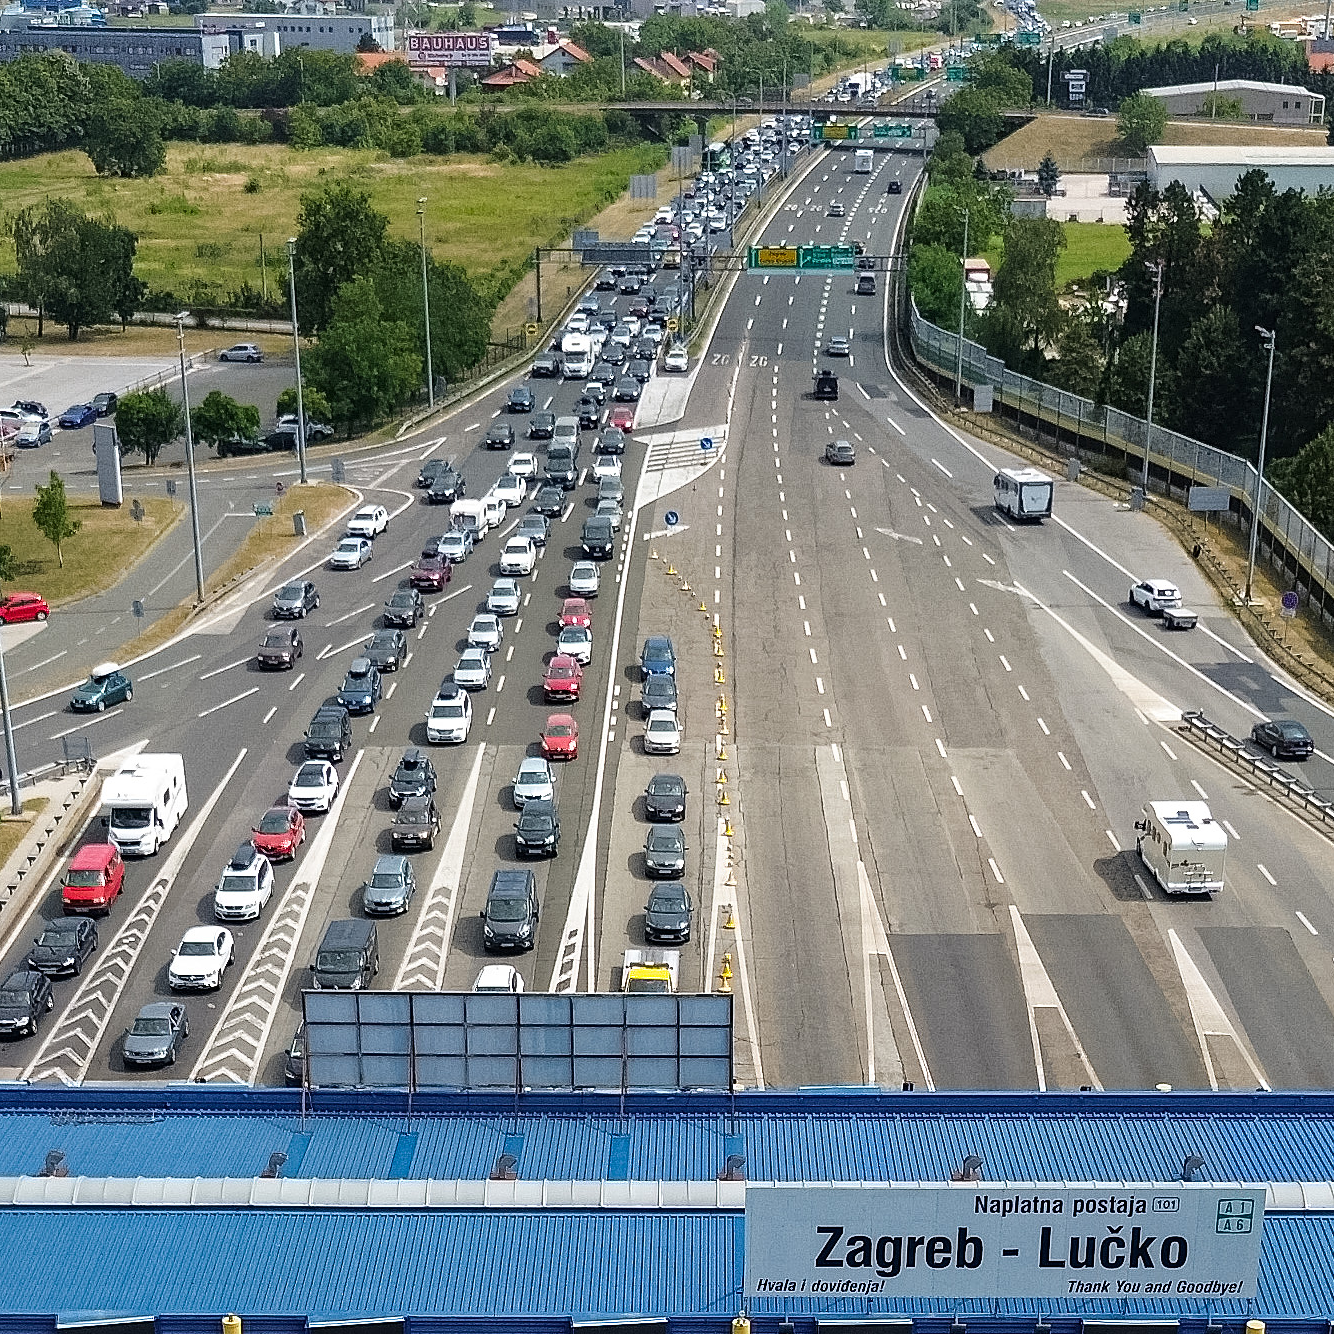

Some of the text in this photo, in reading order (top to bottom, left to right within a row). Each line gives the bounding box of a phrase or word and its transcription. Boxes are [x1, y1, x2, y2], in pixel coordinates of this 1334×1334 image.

[410, 37, 488, 49] BAUHAUS
[974, 1195, 1176, 1218] Naplatna postaja 101
[814, 1225, 984, 1277] Zagreb
[1038, 1225, 1188, 1269] Lučko
[757, 1278, 797, 1292] Hvala
[811, 1279, 886, 1295] doviđenja!
[1067, 1280, 1244, 1296] Thank You and Goodbye!
